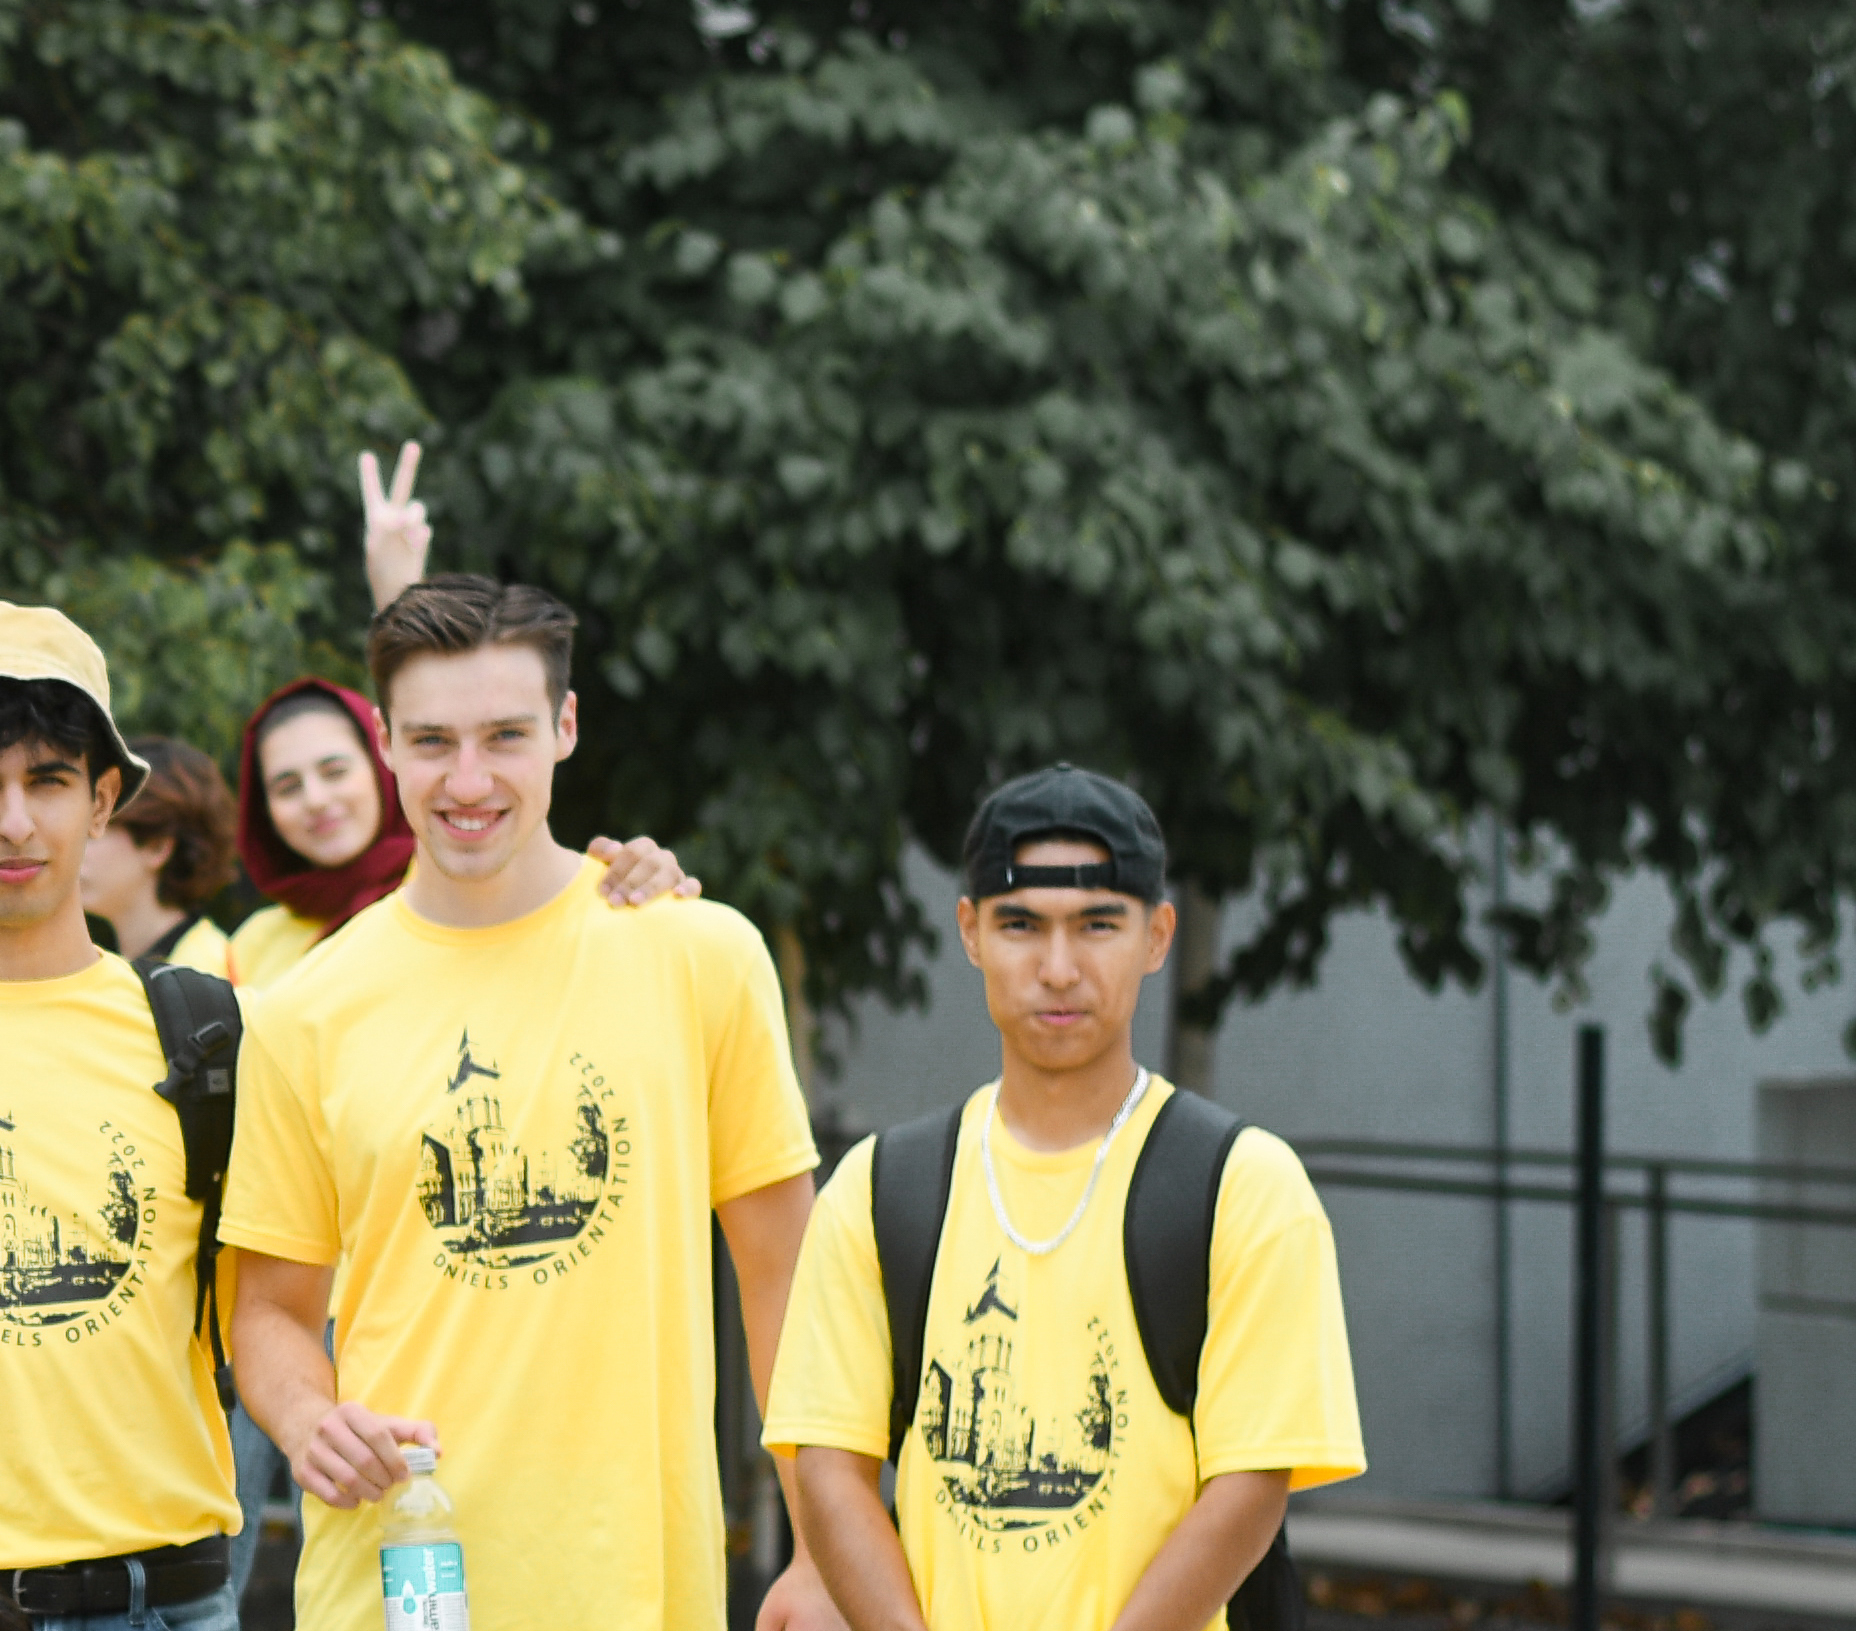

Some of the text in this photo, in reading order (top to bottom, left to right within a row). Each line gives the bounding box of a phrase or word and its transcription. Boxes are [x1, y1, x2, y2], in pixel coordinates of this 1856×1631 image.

[569, 1052, 615, 1101] 2022
[99, 1121, 146, 1170] 2022
[533, 1116, 630, 1285] ORIENTATION
[65, 1186, 157, 1343] ORIENTATION
